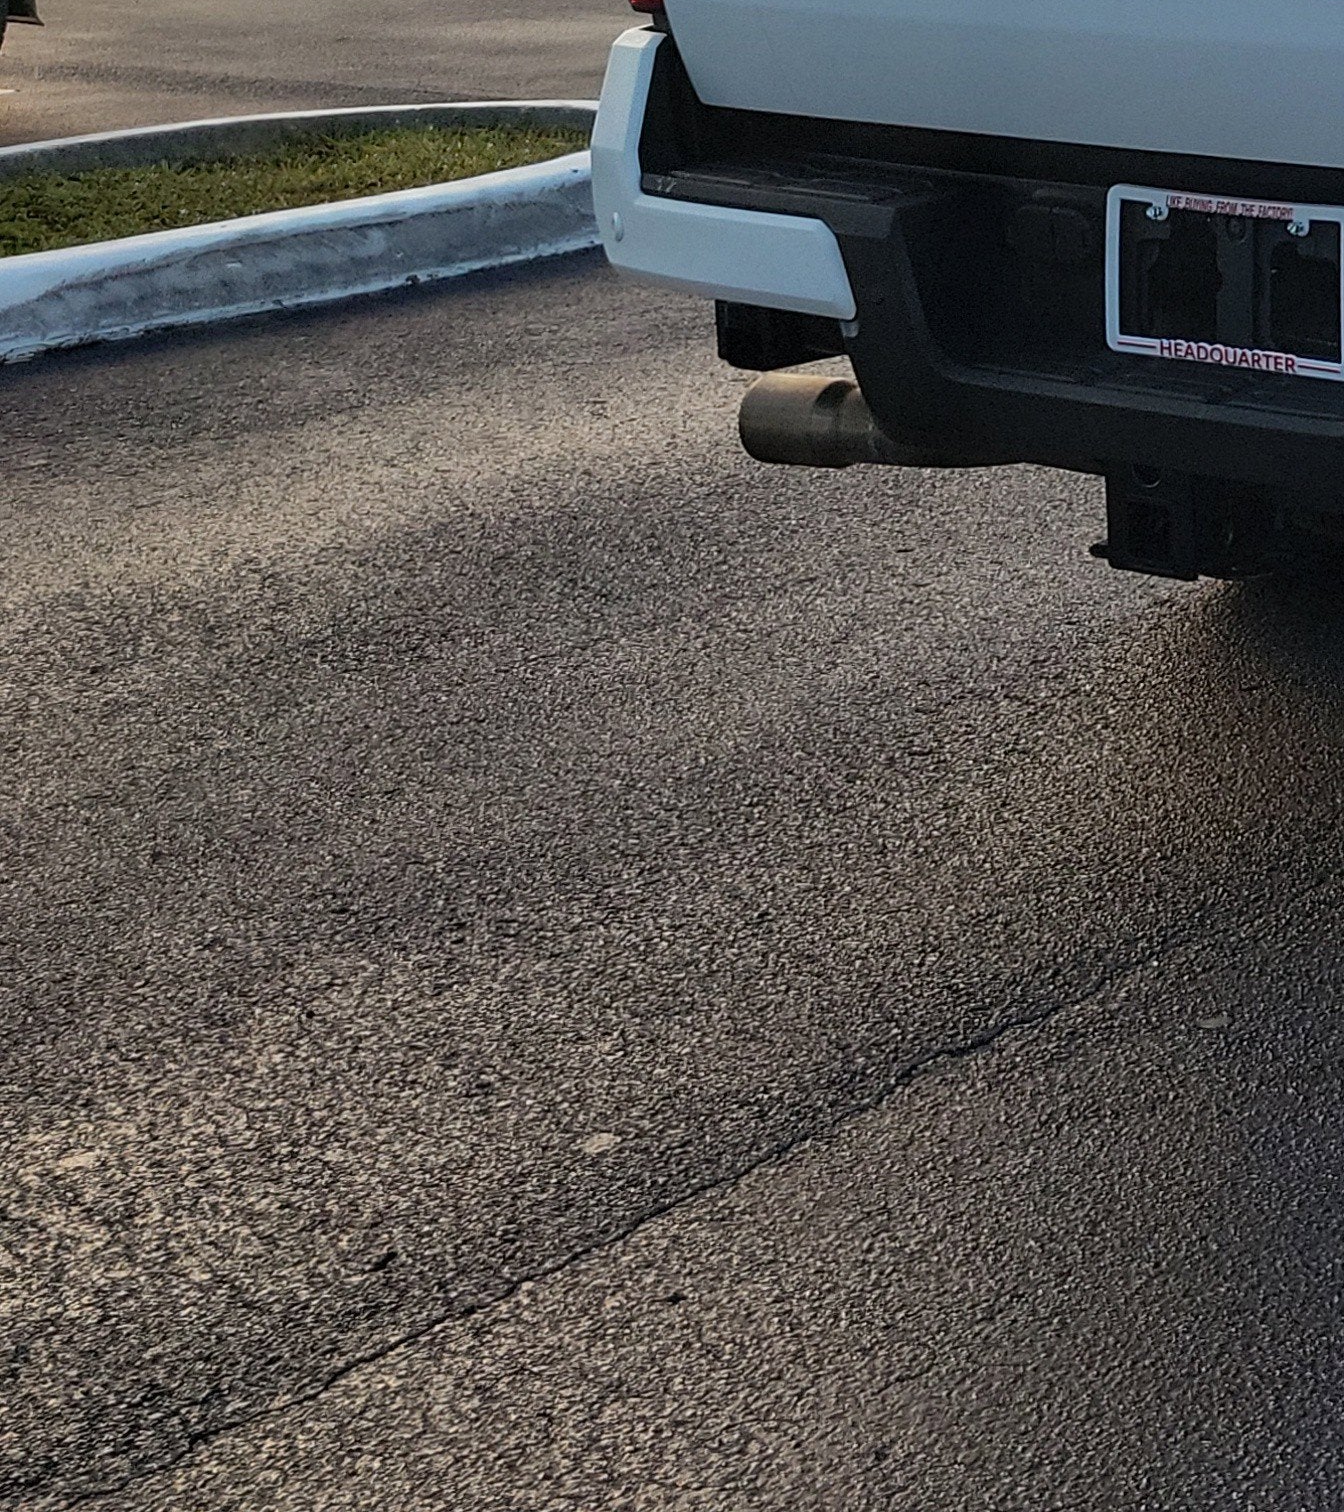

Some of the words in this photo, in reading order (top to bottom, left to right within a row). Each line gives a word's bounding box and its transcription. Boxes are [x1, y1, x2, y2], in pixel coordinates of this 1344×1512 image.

[1166, 194, 1182, 209] LIKE
[1216, 200, 1238, 216] FROM
[1241, 202, 1256, 218] THE
[1159, 339, 1297, 373] HEADQUARTER
